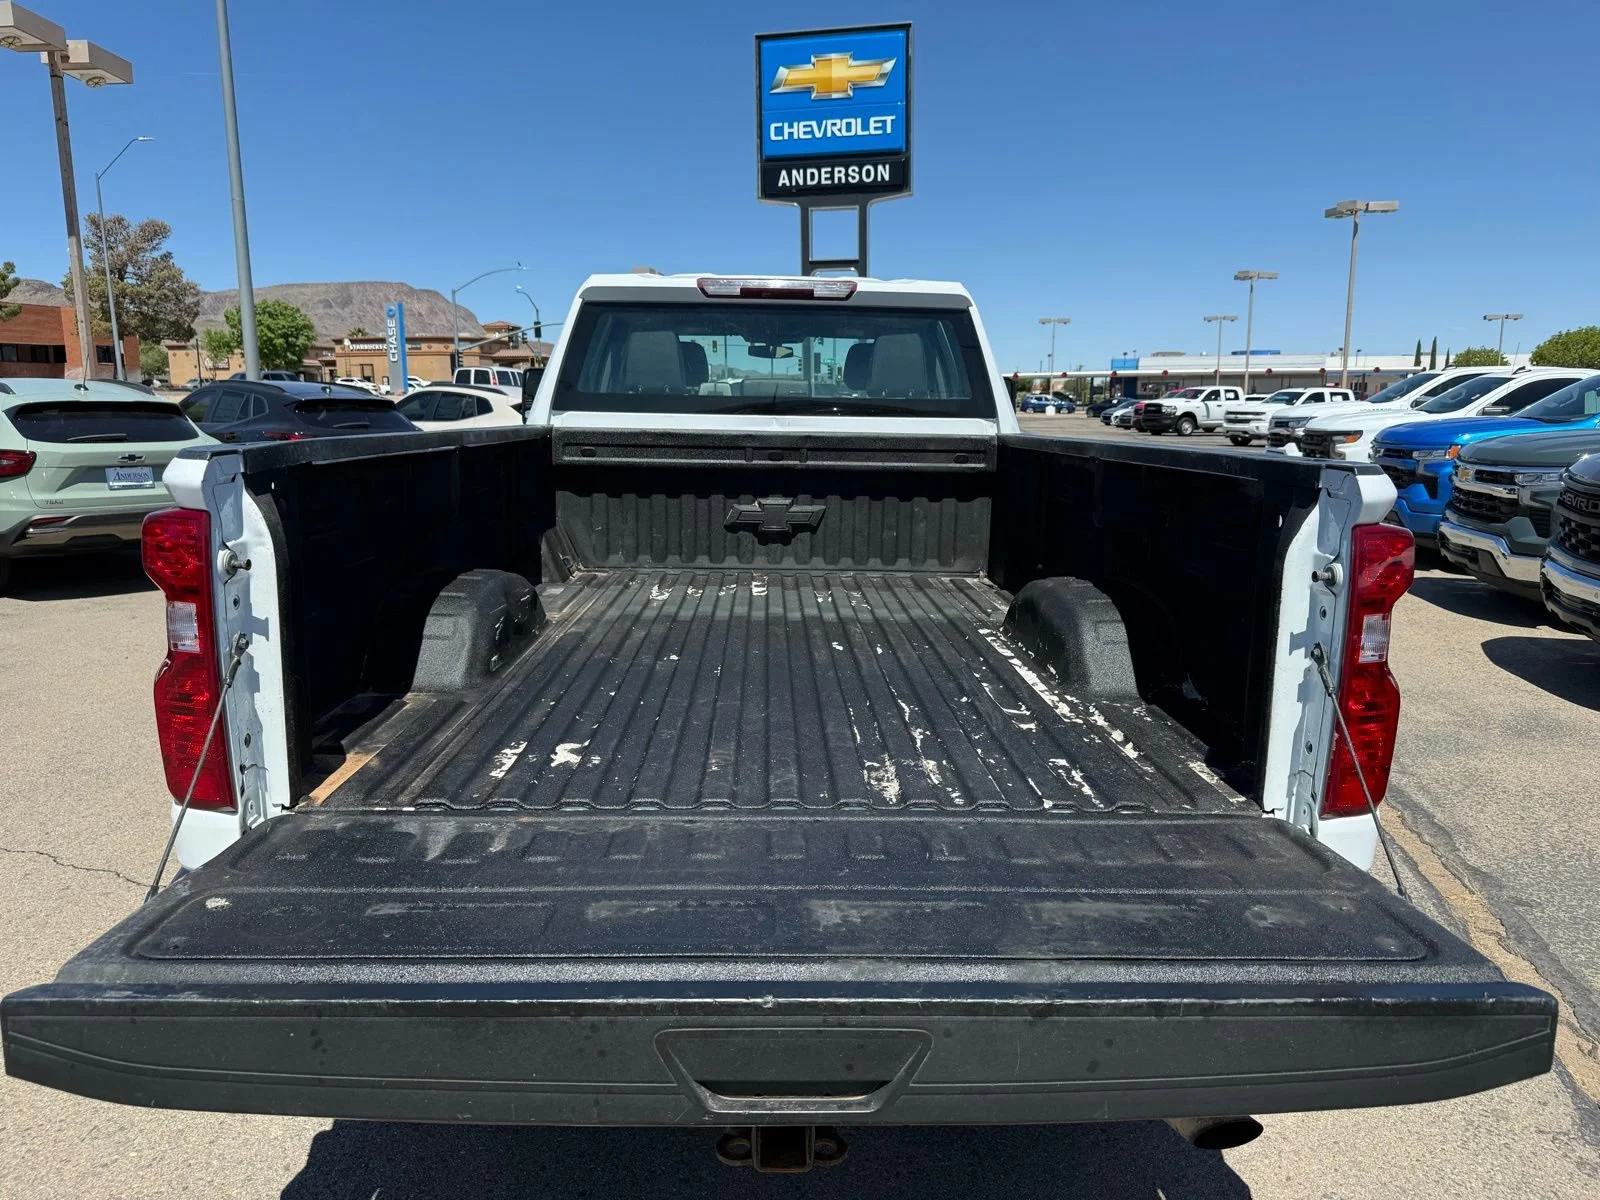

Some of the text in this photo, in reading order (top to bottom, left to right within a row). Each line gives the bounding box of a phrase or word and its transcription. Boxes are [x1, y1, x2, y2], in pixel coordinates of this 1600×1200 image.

[770, 116, 896, 140] CHEVROLET
[778, 164, 890, 187] ANDERSON
[388, 319, 398, 362] CHASE
[112, 471, 151, 480] ANDERSON
